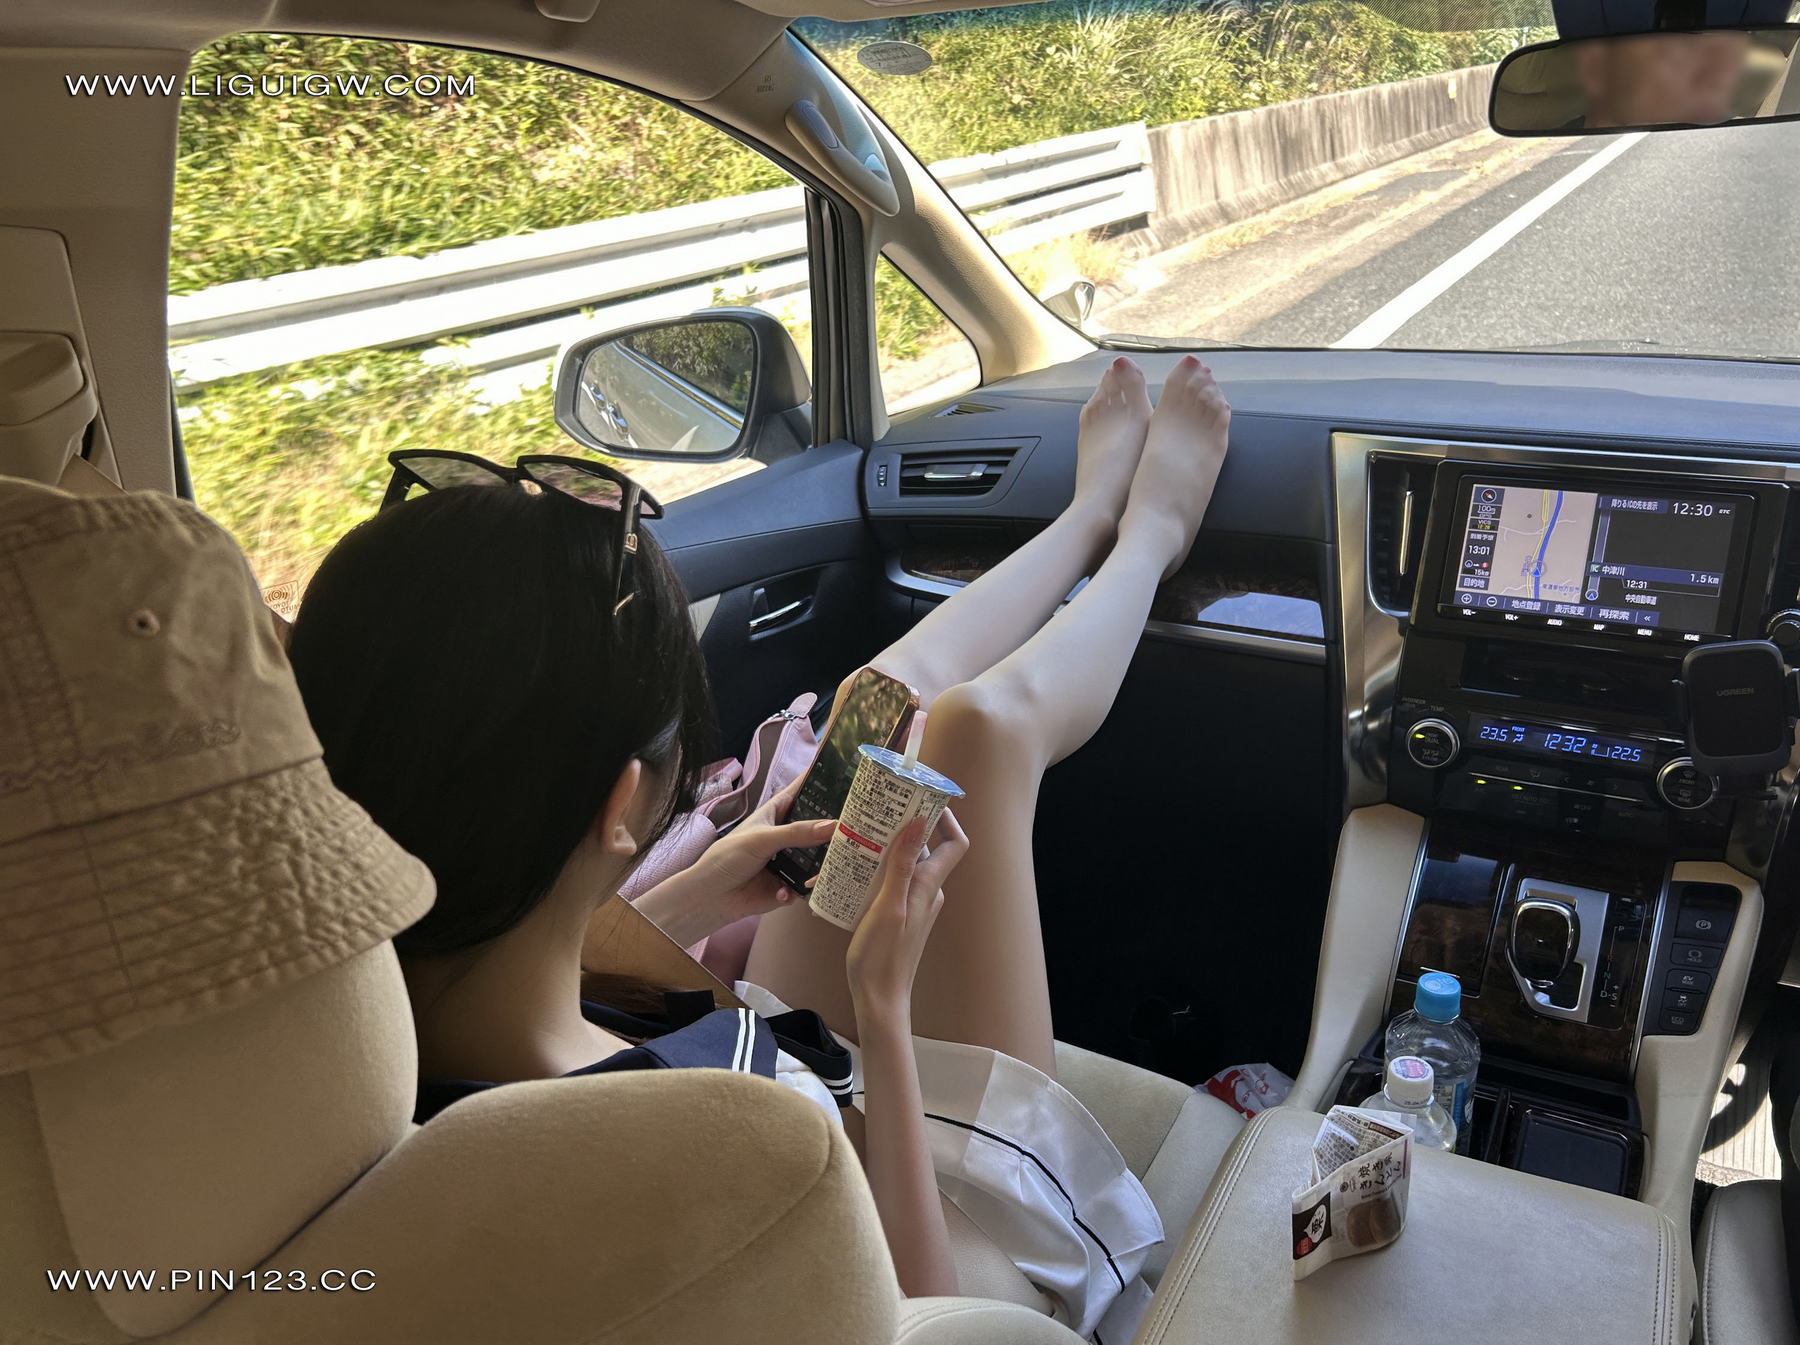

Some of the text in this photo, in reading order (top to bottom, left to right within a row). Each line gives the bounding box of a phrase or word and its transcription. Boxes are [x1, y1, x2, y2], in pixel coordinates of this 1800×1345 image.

[1672, 502, 1713, 517] 12:30
[1468, 545, 1490, 555] 13:01
[1602, 565, 1625, 576] 中津川
[1626, 580, 1648, 589] 12:31
[1716, 687, 1755, 697] UGREEN
[1480, 726, 1508, 742] 23.5
[1611, 744, 1641, 762] 22.5
